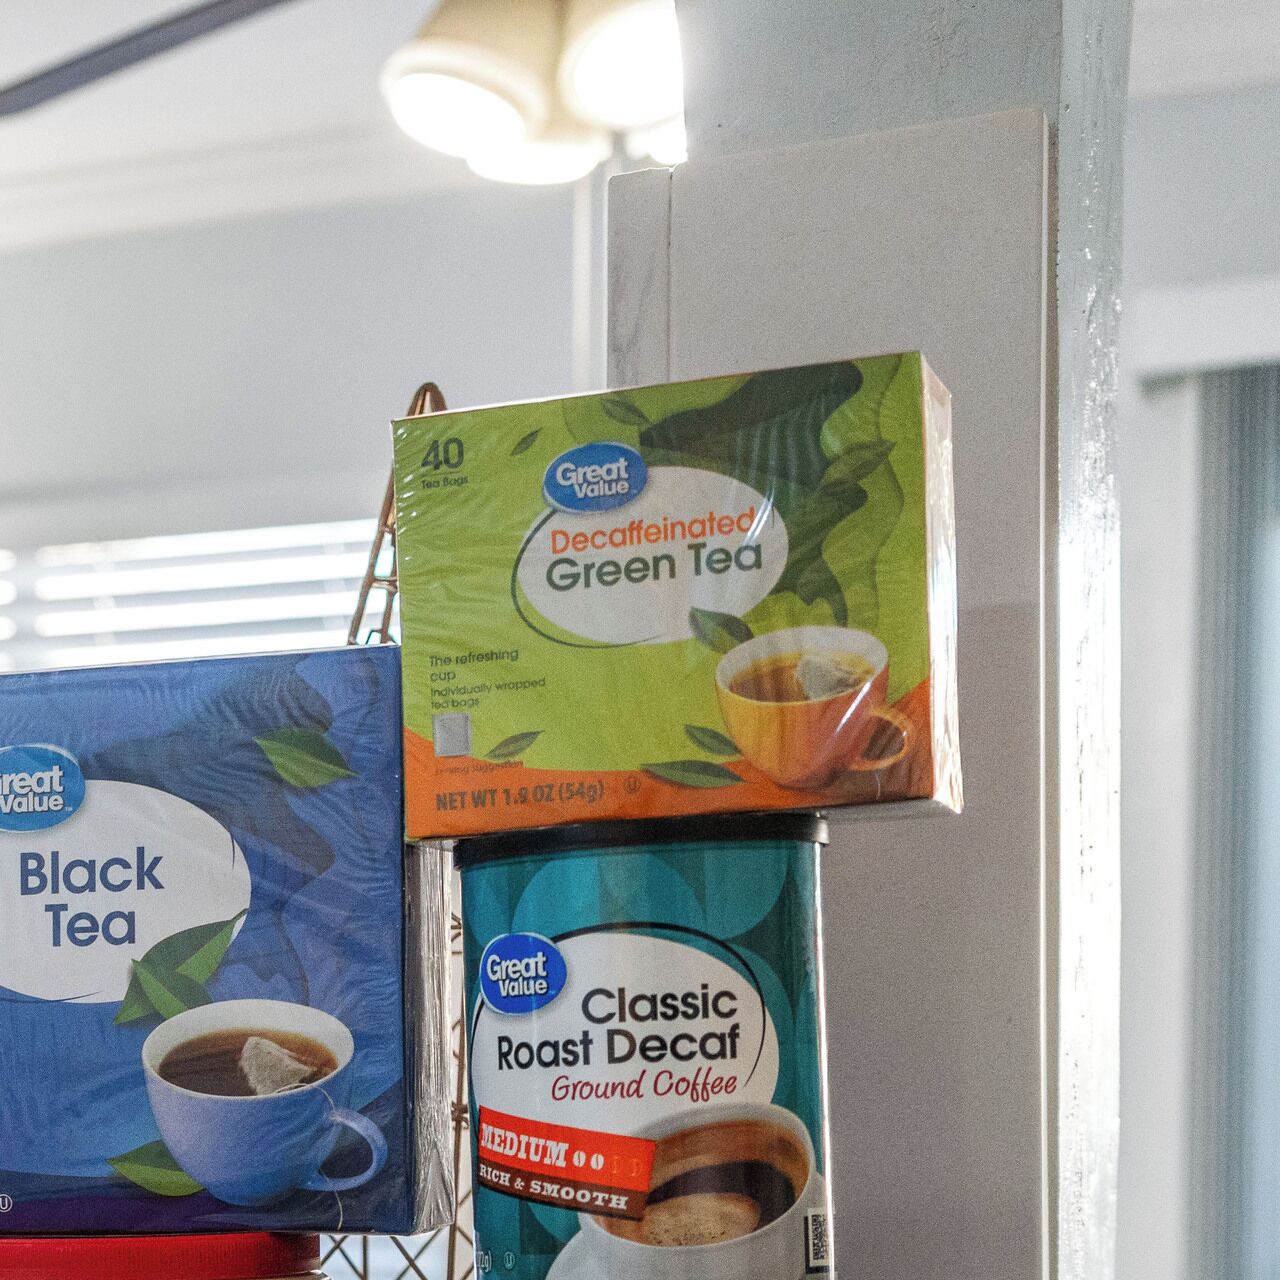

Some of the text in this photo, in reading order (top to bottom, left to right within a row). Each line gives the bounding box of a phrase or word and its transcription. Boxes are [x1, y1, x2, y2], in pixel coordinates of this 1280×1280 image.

[420, 436, 466, 471] 40
[421, 479, 439, 489] Tea
[555, 457, 629, 488] Great
[574, 480, 630, 500] Value
[550, 506, 756, 555] Decaffeinated
[545, 541, 763, 592] Green Tea
[429, 649, 520, 667] The refreshing
[430, 670, 456, 683] cup
[430, 678, 546, 698] Individually wrapped
[451, 698, 480, 709] bags
[435, 791, 467, 812] NET
[471, 788, 497, 808] WT
[532, 783, 554, 802] OZ
[20, 846, 165, 896] Black
[44, 903, 136, 947] Tea
[487, 952, 547, 981] Great
[499, 977, 548, 997] Value
[582, 983, 738, 1024] Classic
[497, 1023, 740, 1071] Roast Decaf
[552, 1066, 738, 1103] Ground Coffee
[481, 1122, 569, 1168] MEDIUM
[479, 1163, 629, 1210] RICH & SMOOTH
